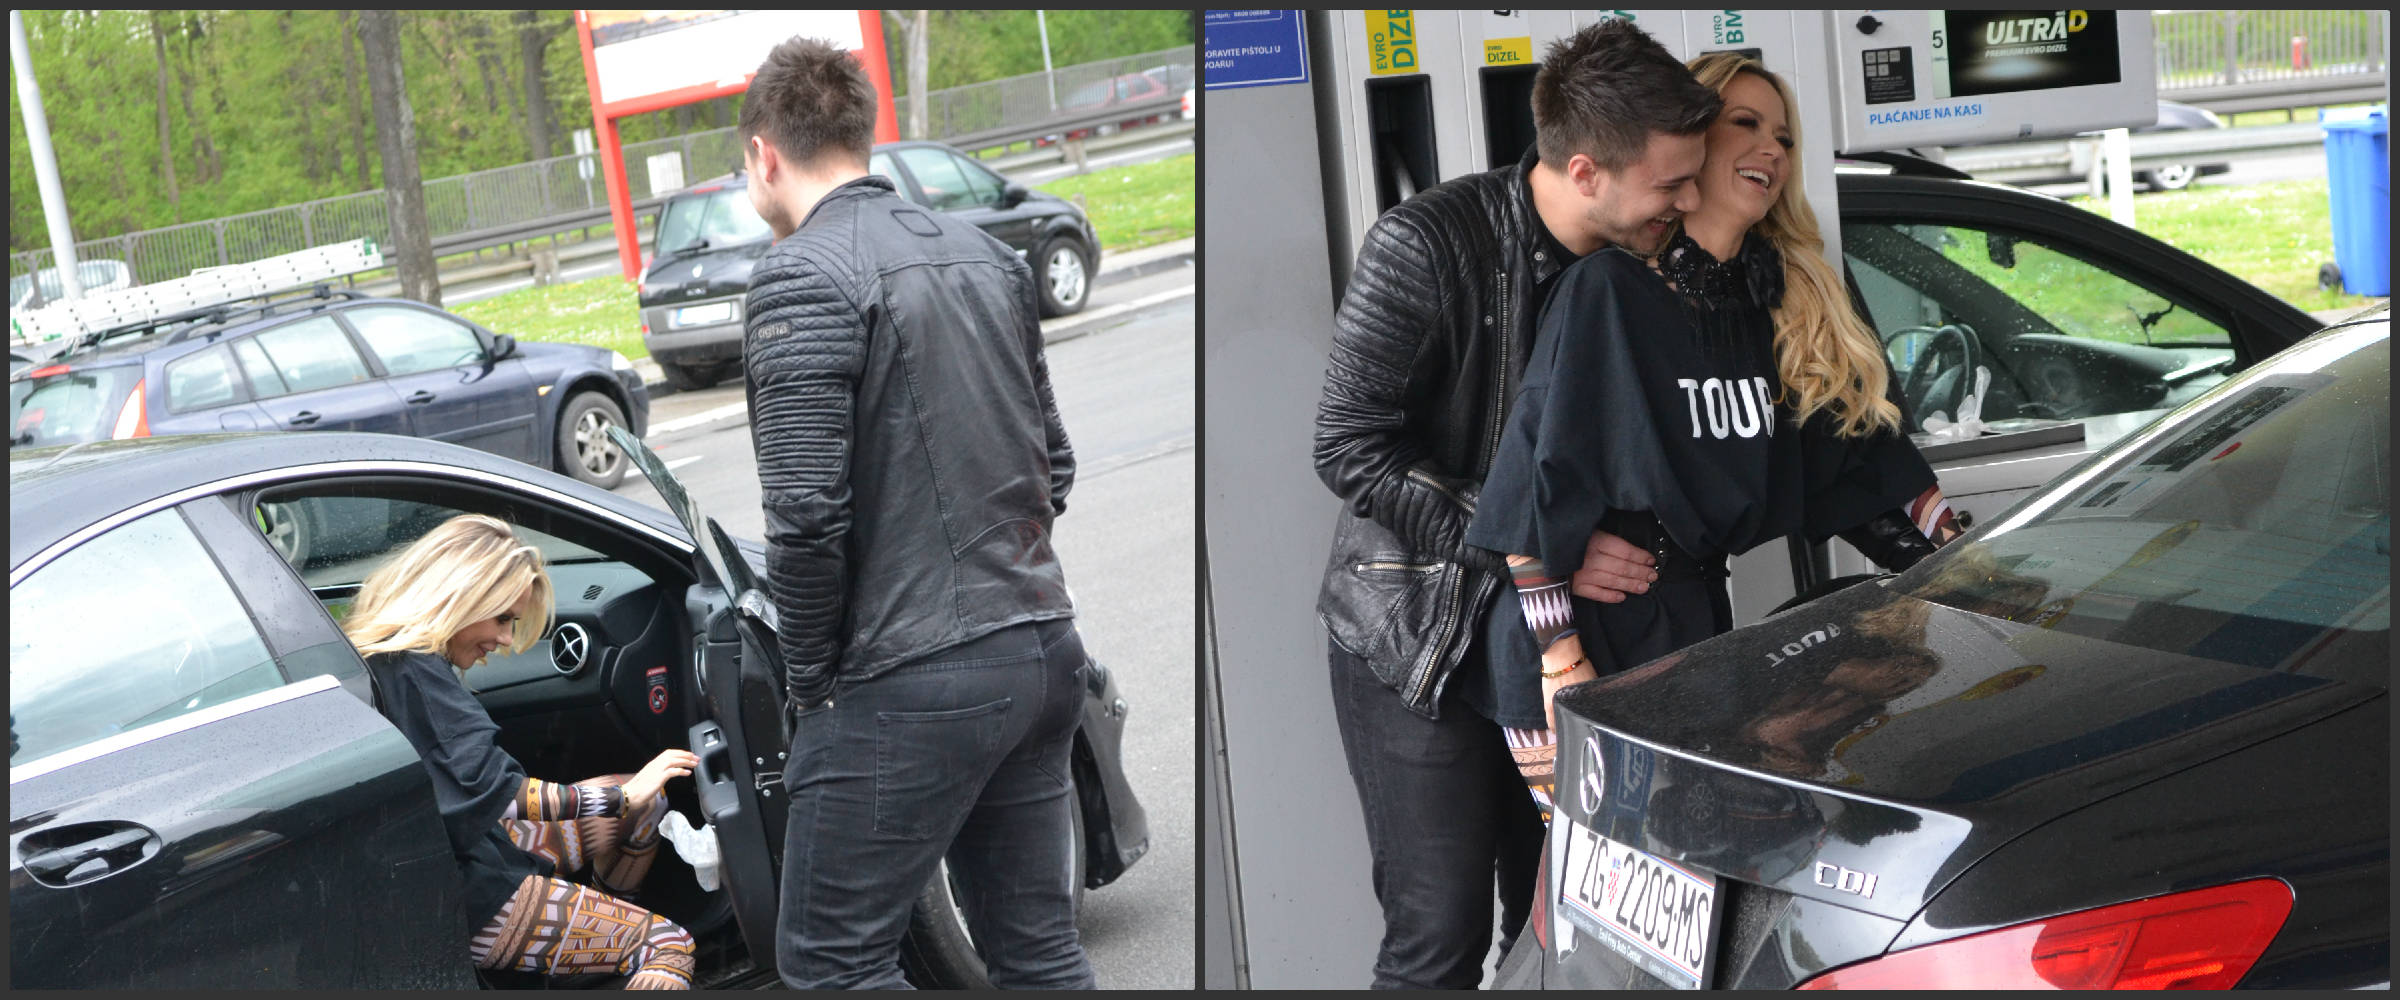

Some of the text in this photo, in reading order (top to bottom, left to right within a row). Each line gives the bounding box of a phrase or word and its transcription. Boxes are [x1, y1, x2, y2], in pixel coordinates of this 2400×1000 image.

[1713, 15, 1723, 44] EVRO
[1932, 30, 1944, 48] 5
[1274, 45, 1281, 53] U
[1374, 32, 1388, 69] EVRO
[1488, 51, 1520, 63] DIZEL
[2024, 46, 2045, 55] EVRO
[2046, 44, 2067, 53] DIZEL
[1870, 103, 1982, 125] PLAĆANJE NA KASI
[1579, 831, 1608, 909] ZG
[1815, 861, 1878, 899] CDI
